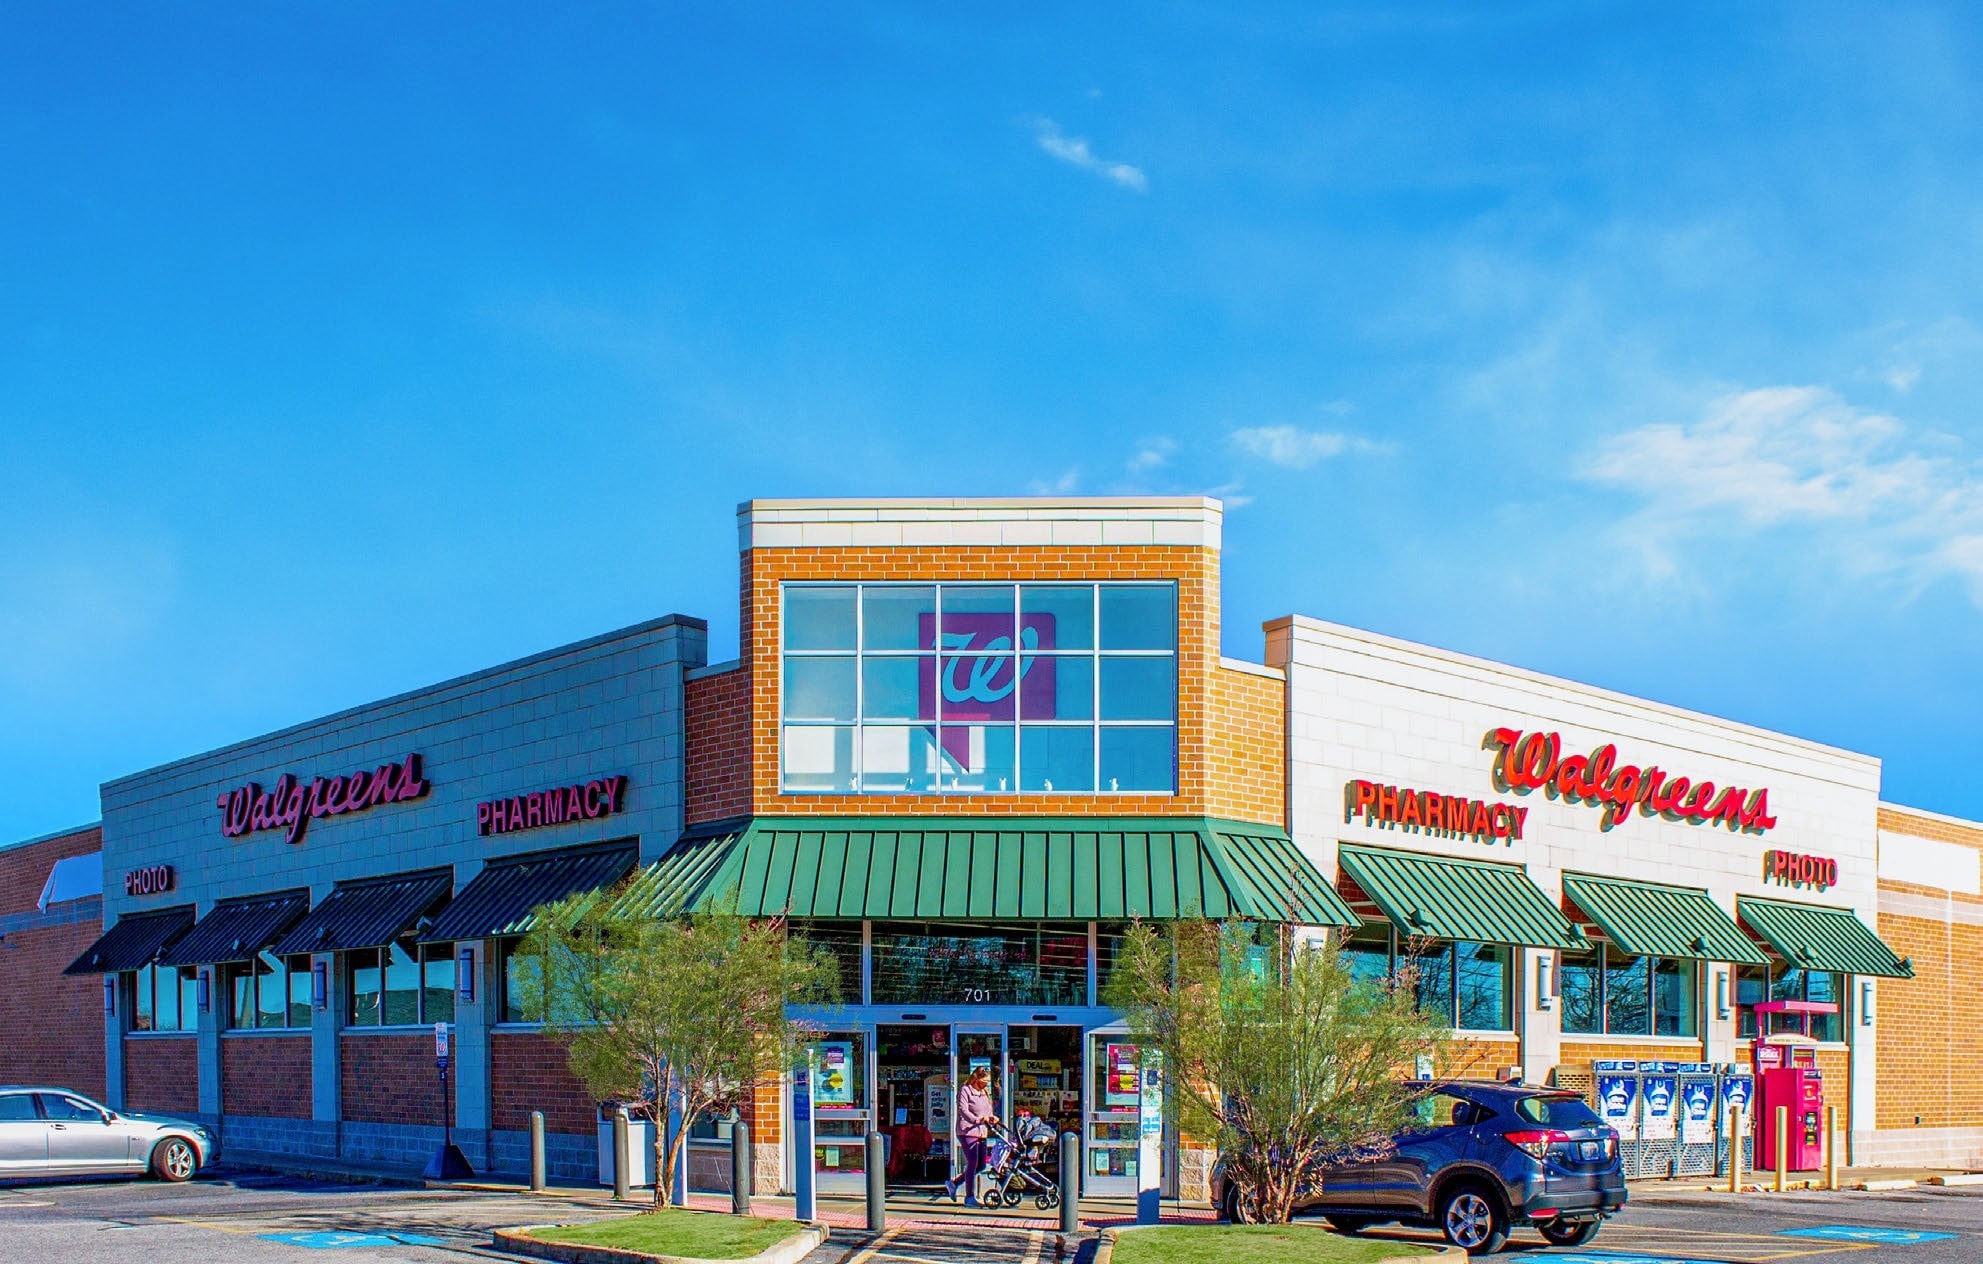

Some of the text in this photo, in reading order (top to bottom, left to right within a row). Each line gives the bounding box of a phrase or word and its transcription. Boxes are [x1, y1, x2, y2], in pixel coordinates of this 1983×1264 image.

[217, 753, 430, 844] Walgreens
[477, 776, 626, 836] PHARMACY
[1493, 727, 1778, 836] Walgreens
[1354, 779, 1529, 841] PHARMACY
[125, 865, 171, 895] PHOTO
[1774, 850, 1838, 888] PHOTO
[964, 988, 990, 1002] 701
[1026, 1061, 1044, 1069] DEAL
